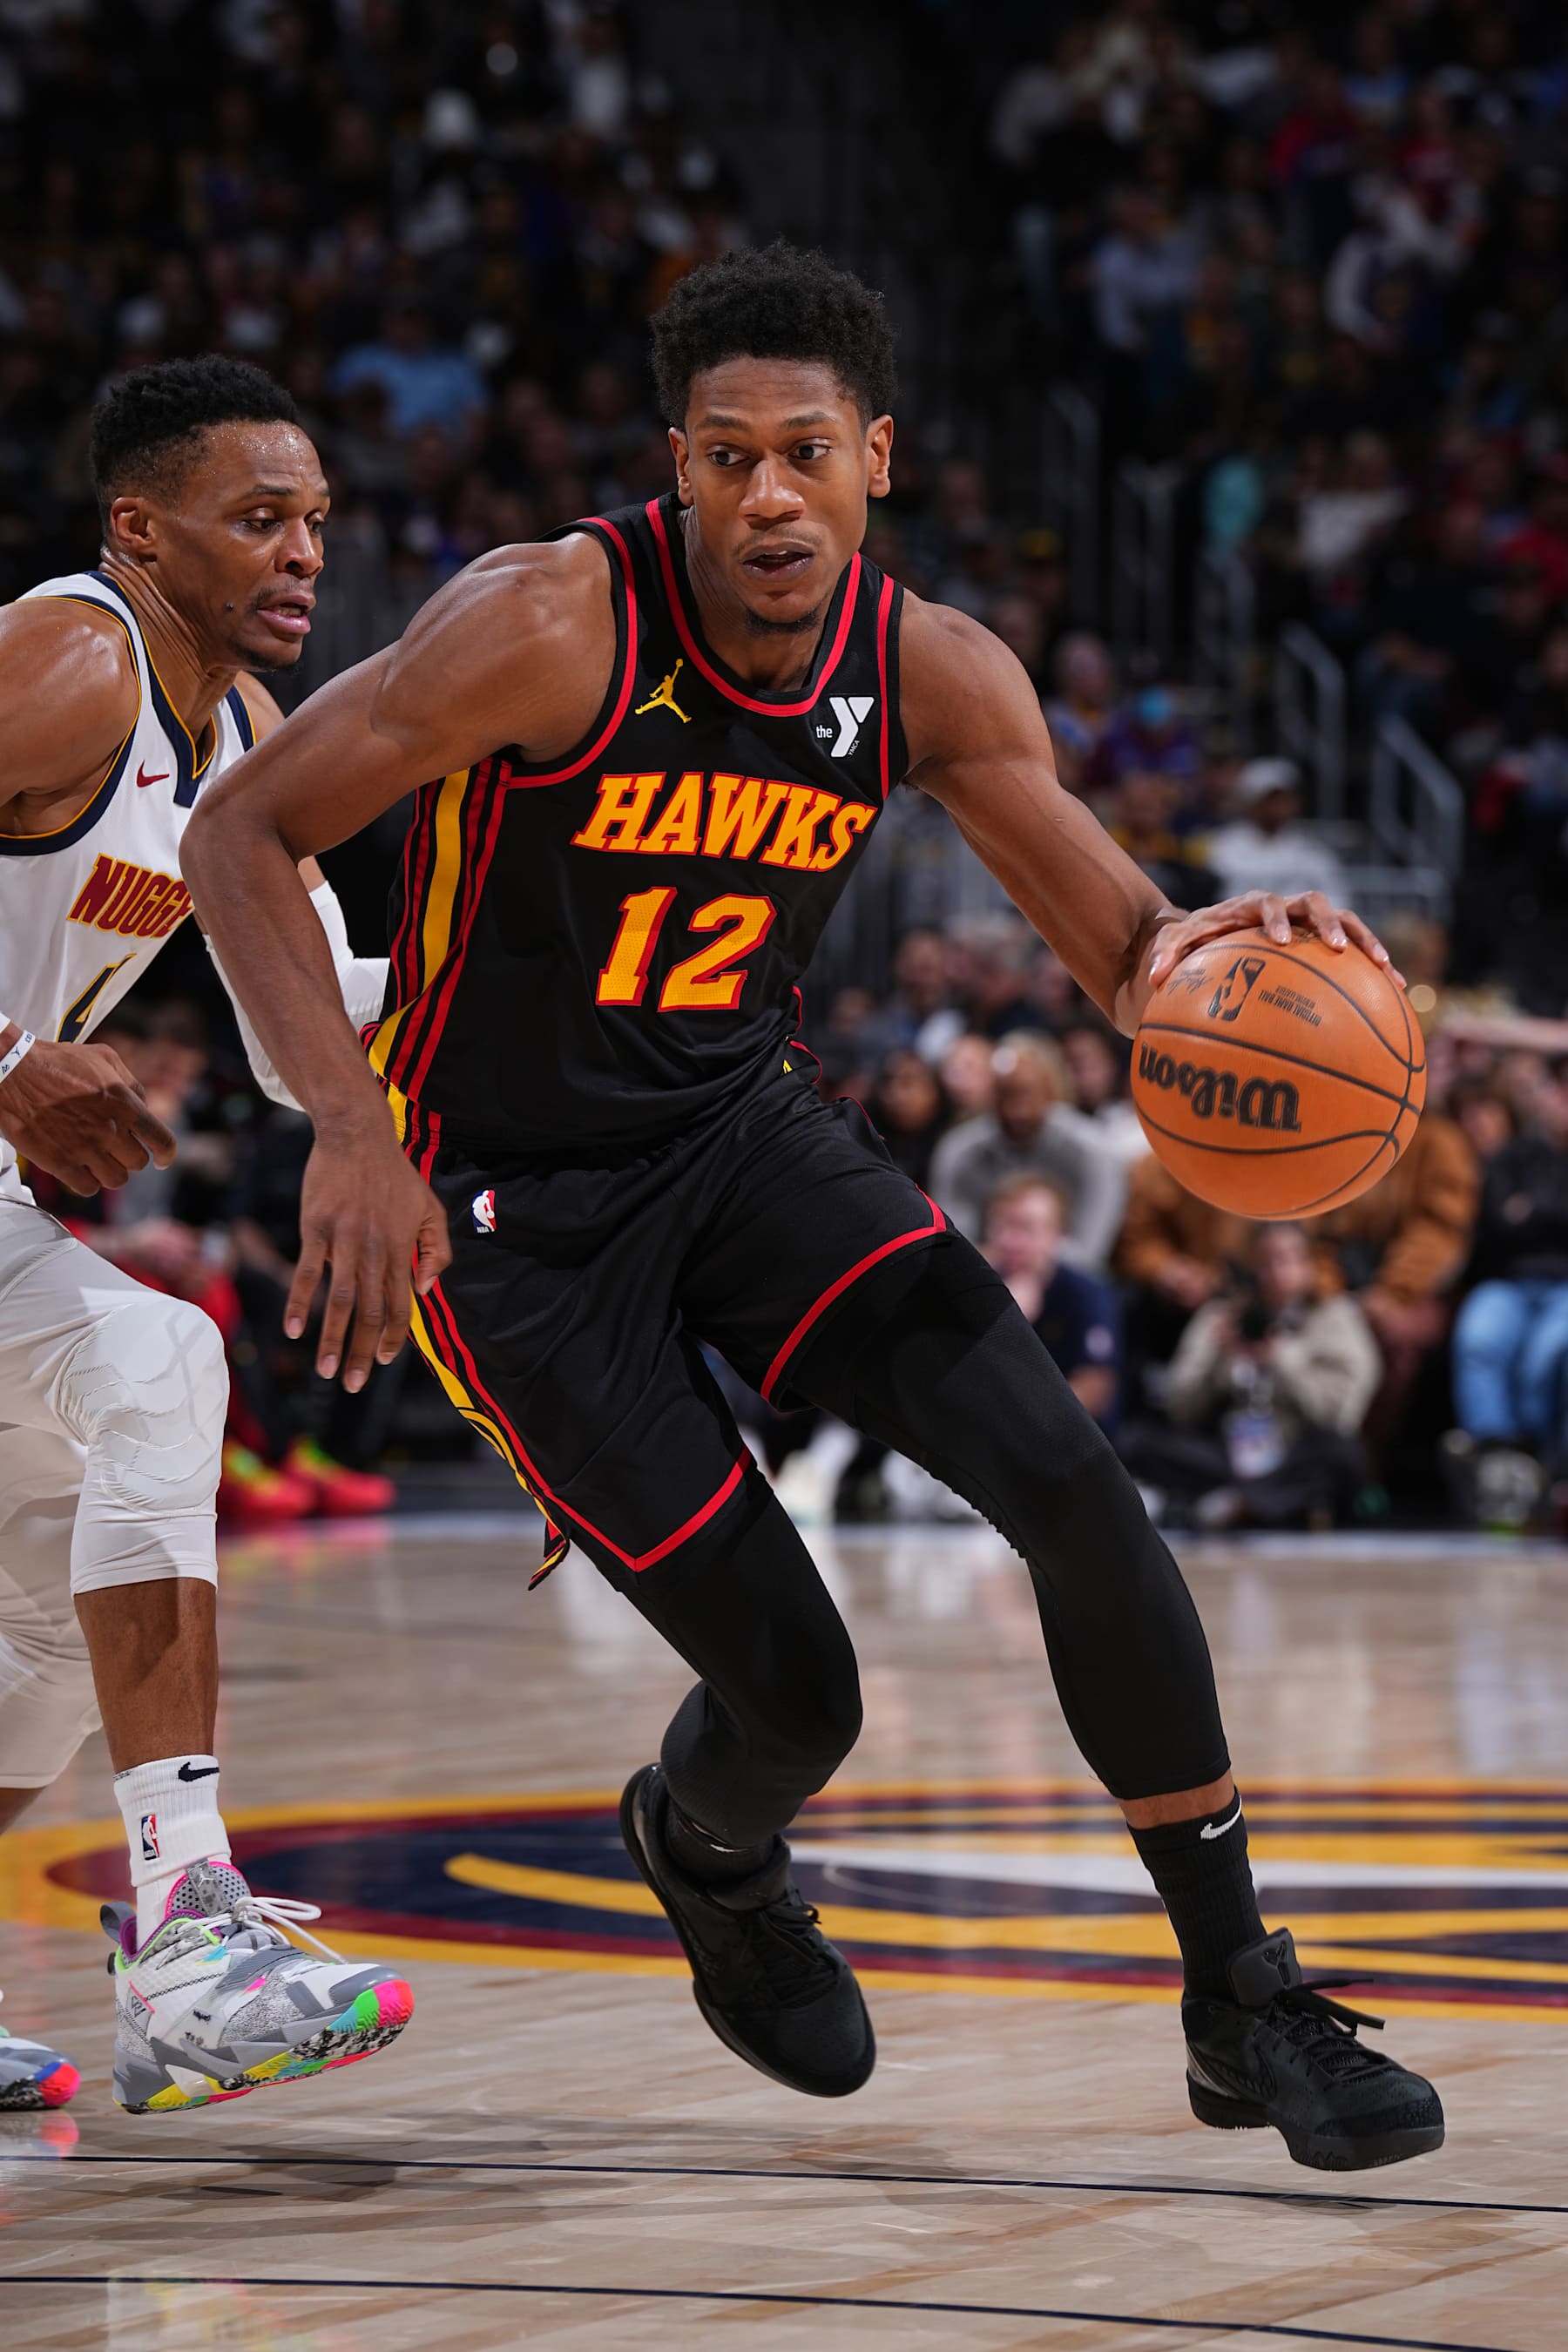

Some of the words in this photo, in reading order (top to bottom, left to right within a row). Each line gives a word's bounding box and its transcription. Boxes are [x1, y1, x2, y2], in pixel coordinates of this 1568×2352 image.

[816, 725, 834, 739] the
[848, 740, 861, 756] YMCA
[570, 772, 879, 871] HAWKS
[595, 886, 777, 1012] 12
[1258, 989, 1275, 1004] BALL
[1139, 1042, 1302, 1132] Wilson
